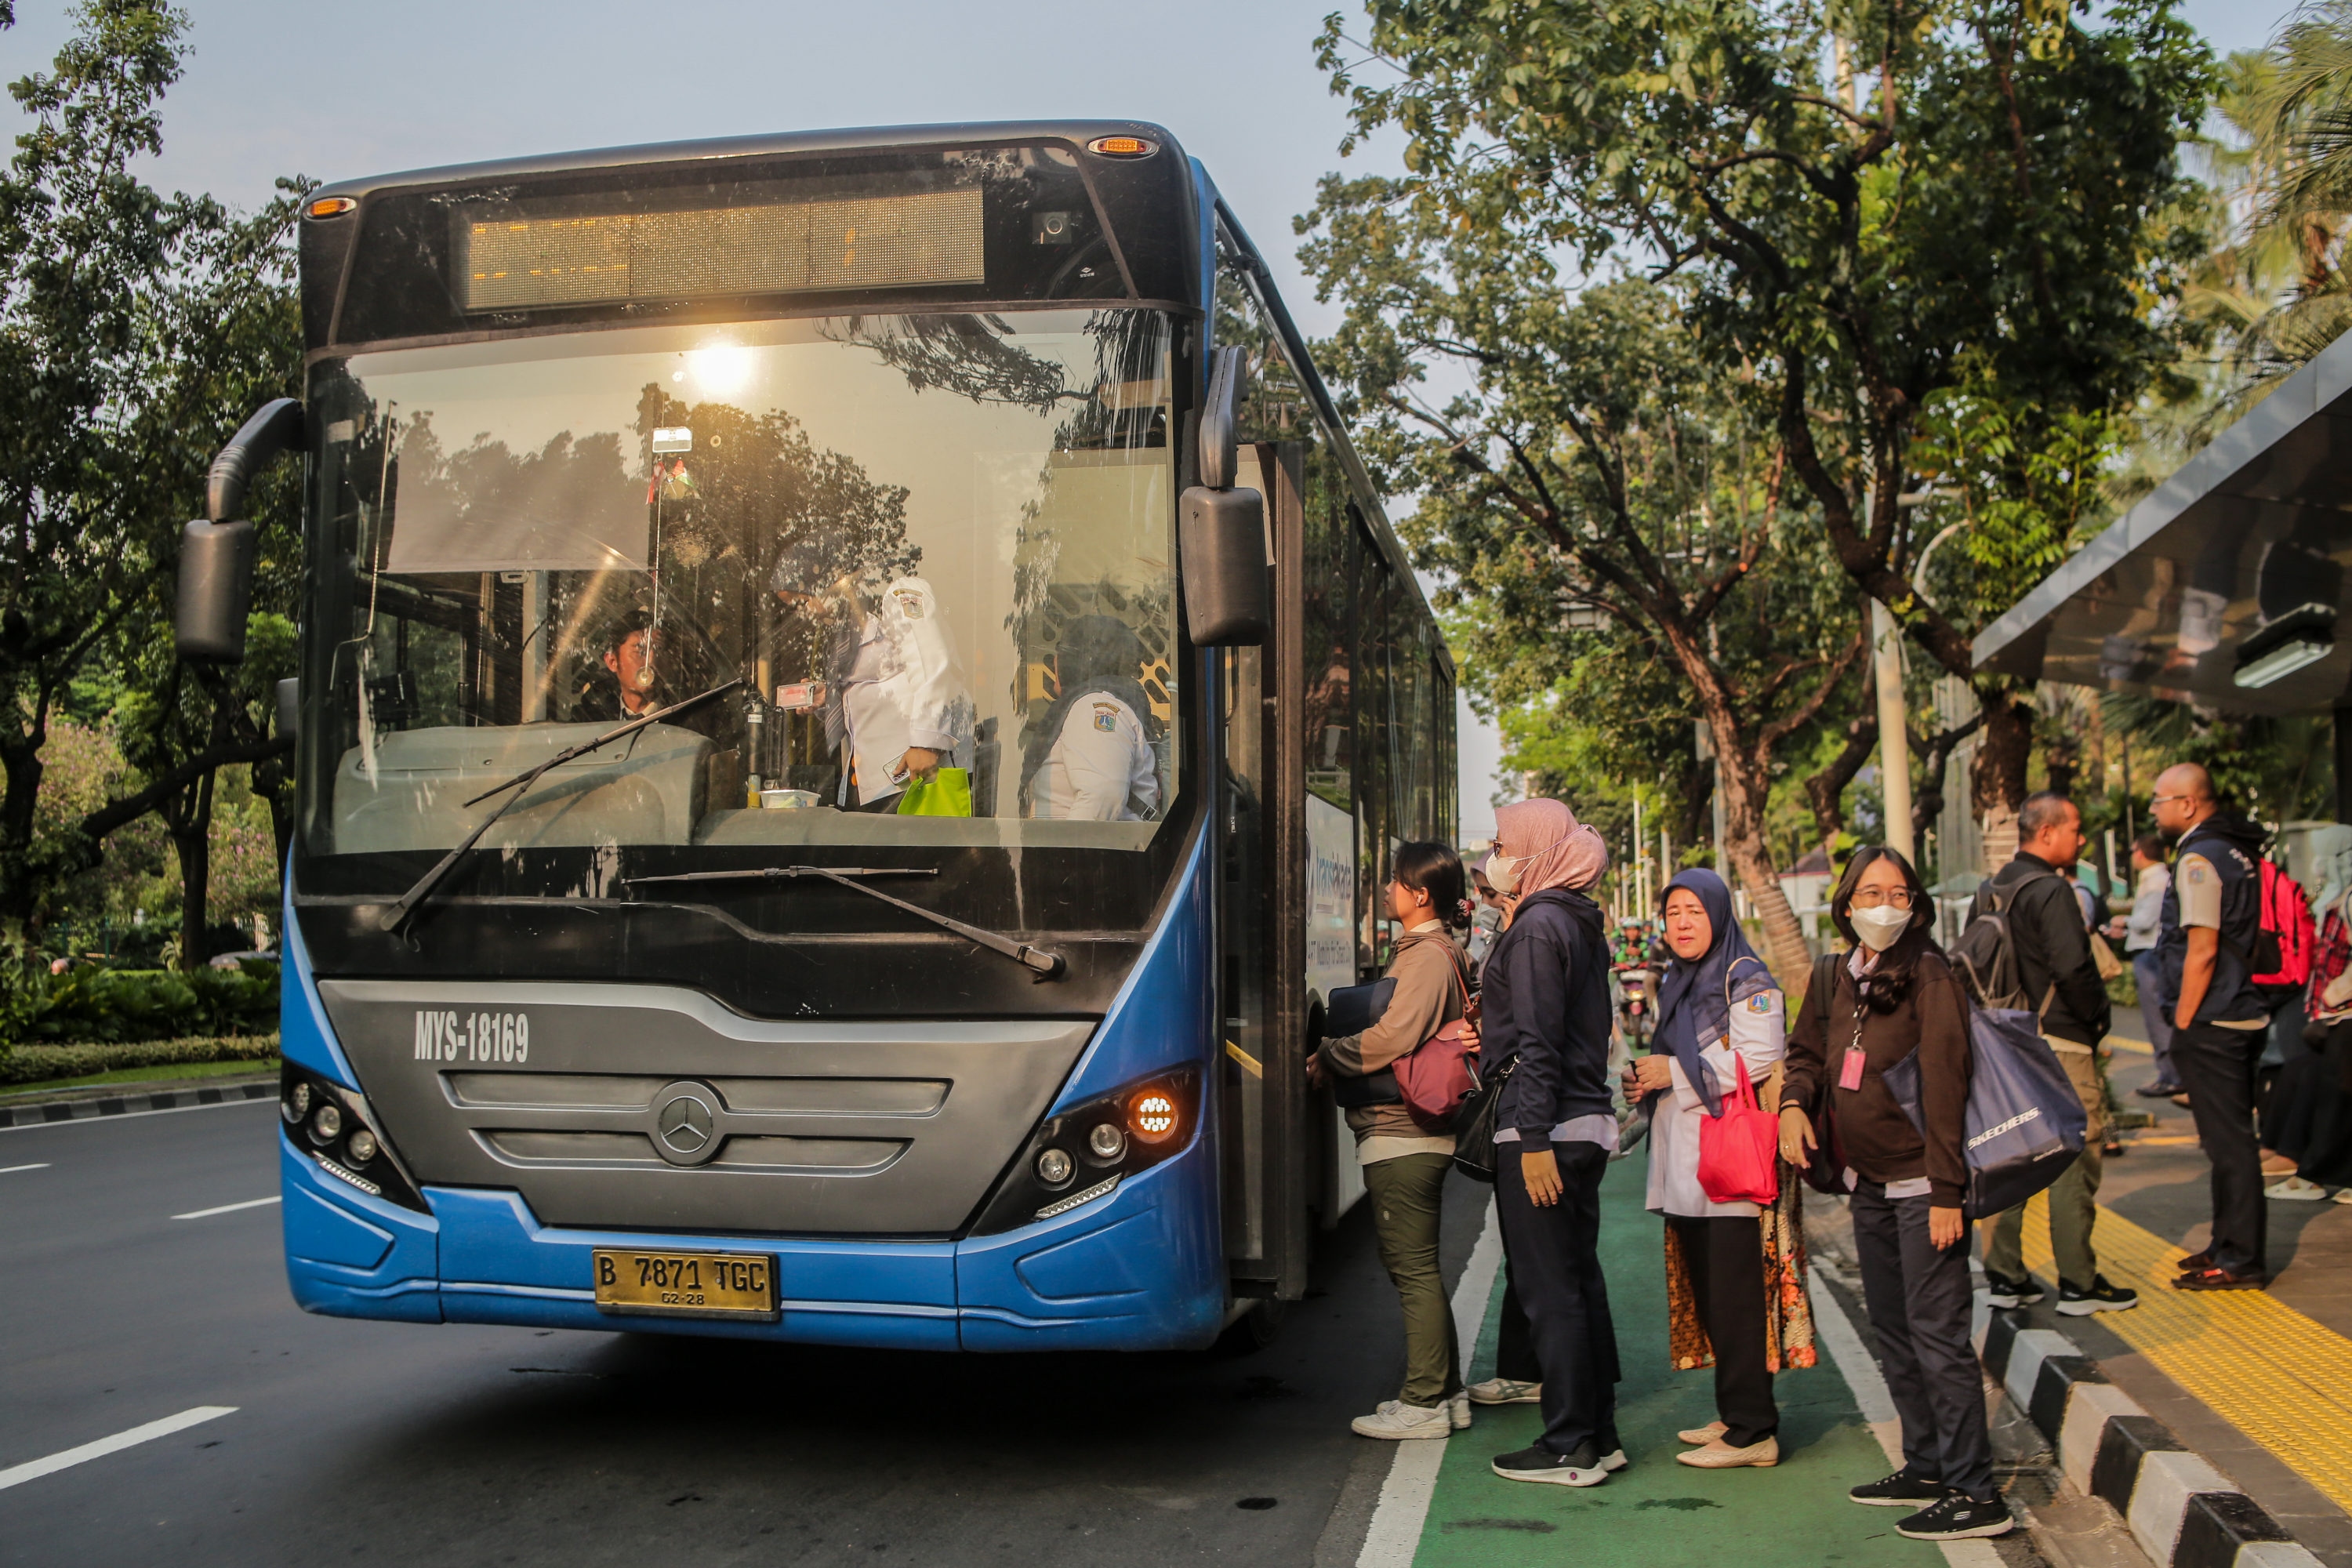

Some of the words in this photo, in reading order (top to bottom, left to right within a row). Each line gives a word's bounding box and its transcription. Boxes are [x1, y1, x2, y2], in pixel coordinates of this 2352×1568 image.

[415, 1011, 529, 1062] MYS-18169
[1968, 1106, 2039, 1150] SKECHERS
[600, 1257, 616, 1286] B
[635, 1258, 702, 1290] 7871
[713, 1261, 764, 1292] TGC
